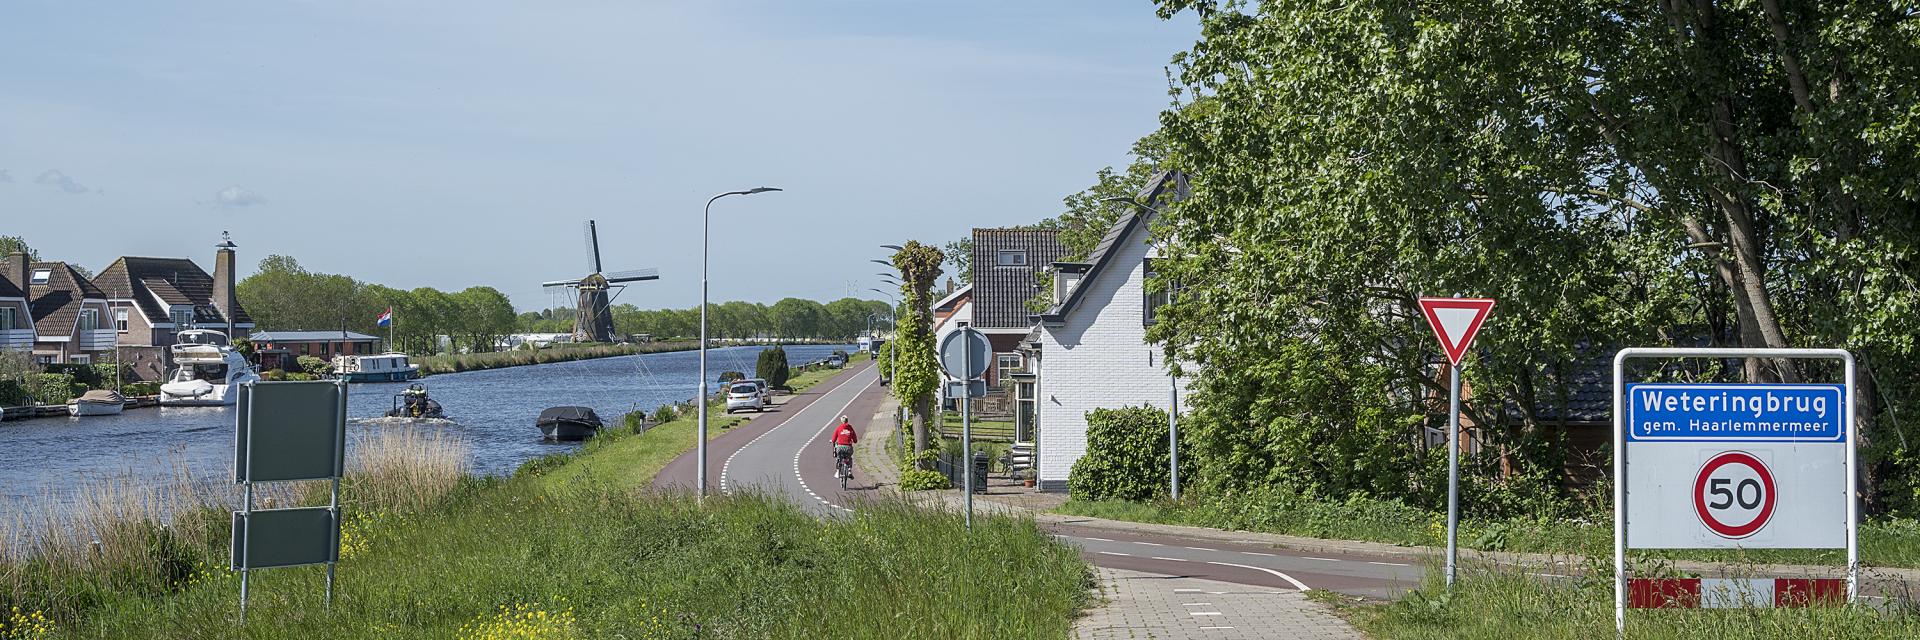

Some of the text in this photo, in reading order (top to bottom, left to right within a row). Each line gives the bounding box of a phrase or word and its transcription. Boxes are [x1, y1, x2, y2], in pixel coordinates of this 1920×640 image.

[1642, 391, 1827, 418] Weteringbrug
[1643, 419, 1829, 434] gem. Haarlemmermeer
[1709, 478, 1762, 510] 50
